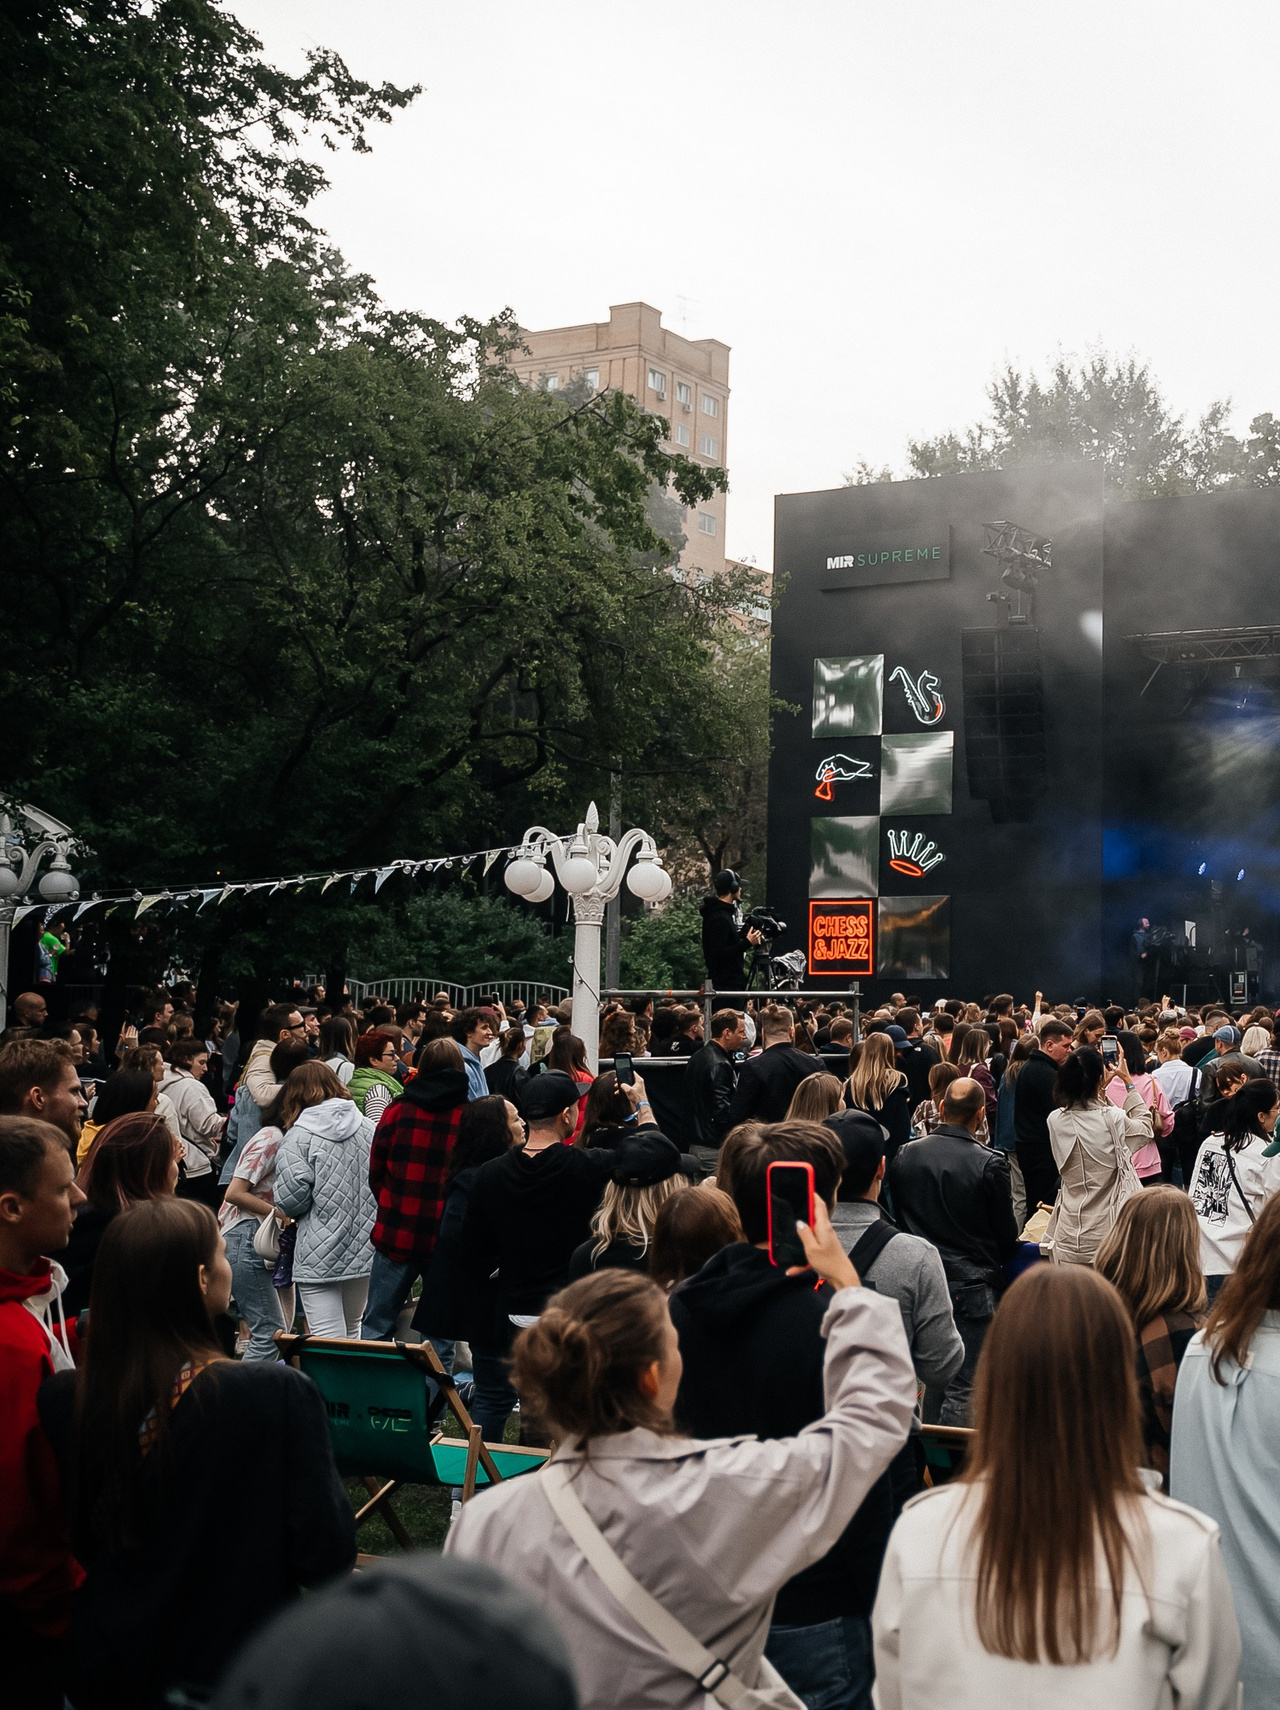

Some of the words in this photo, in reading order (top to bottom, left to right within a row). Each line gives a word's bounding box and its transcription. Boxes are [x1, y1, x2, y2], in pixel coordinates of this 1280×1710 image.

[826, 554, 854, 570] MIR
[856, 546, 941, 567] SUPREME
[813, 915, 868, 937] CHESS
